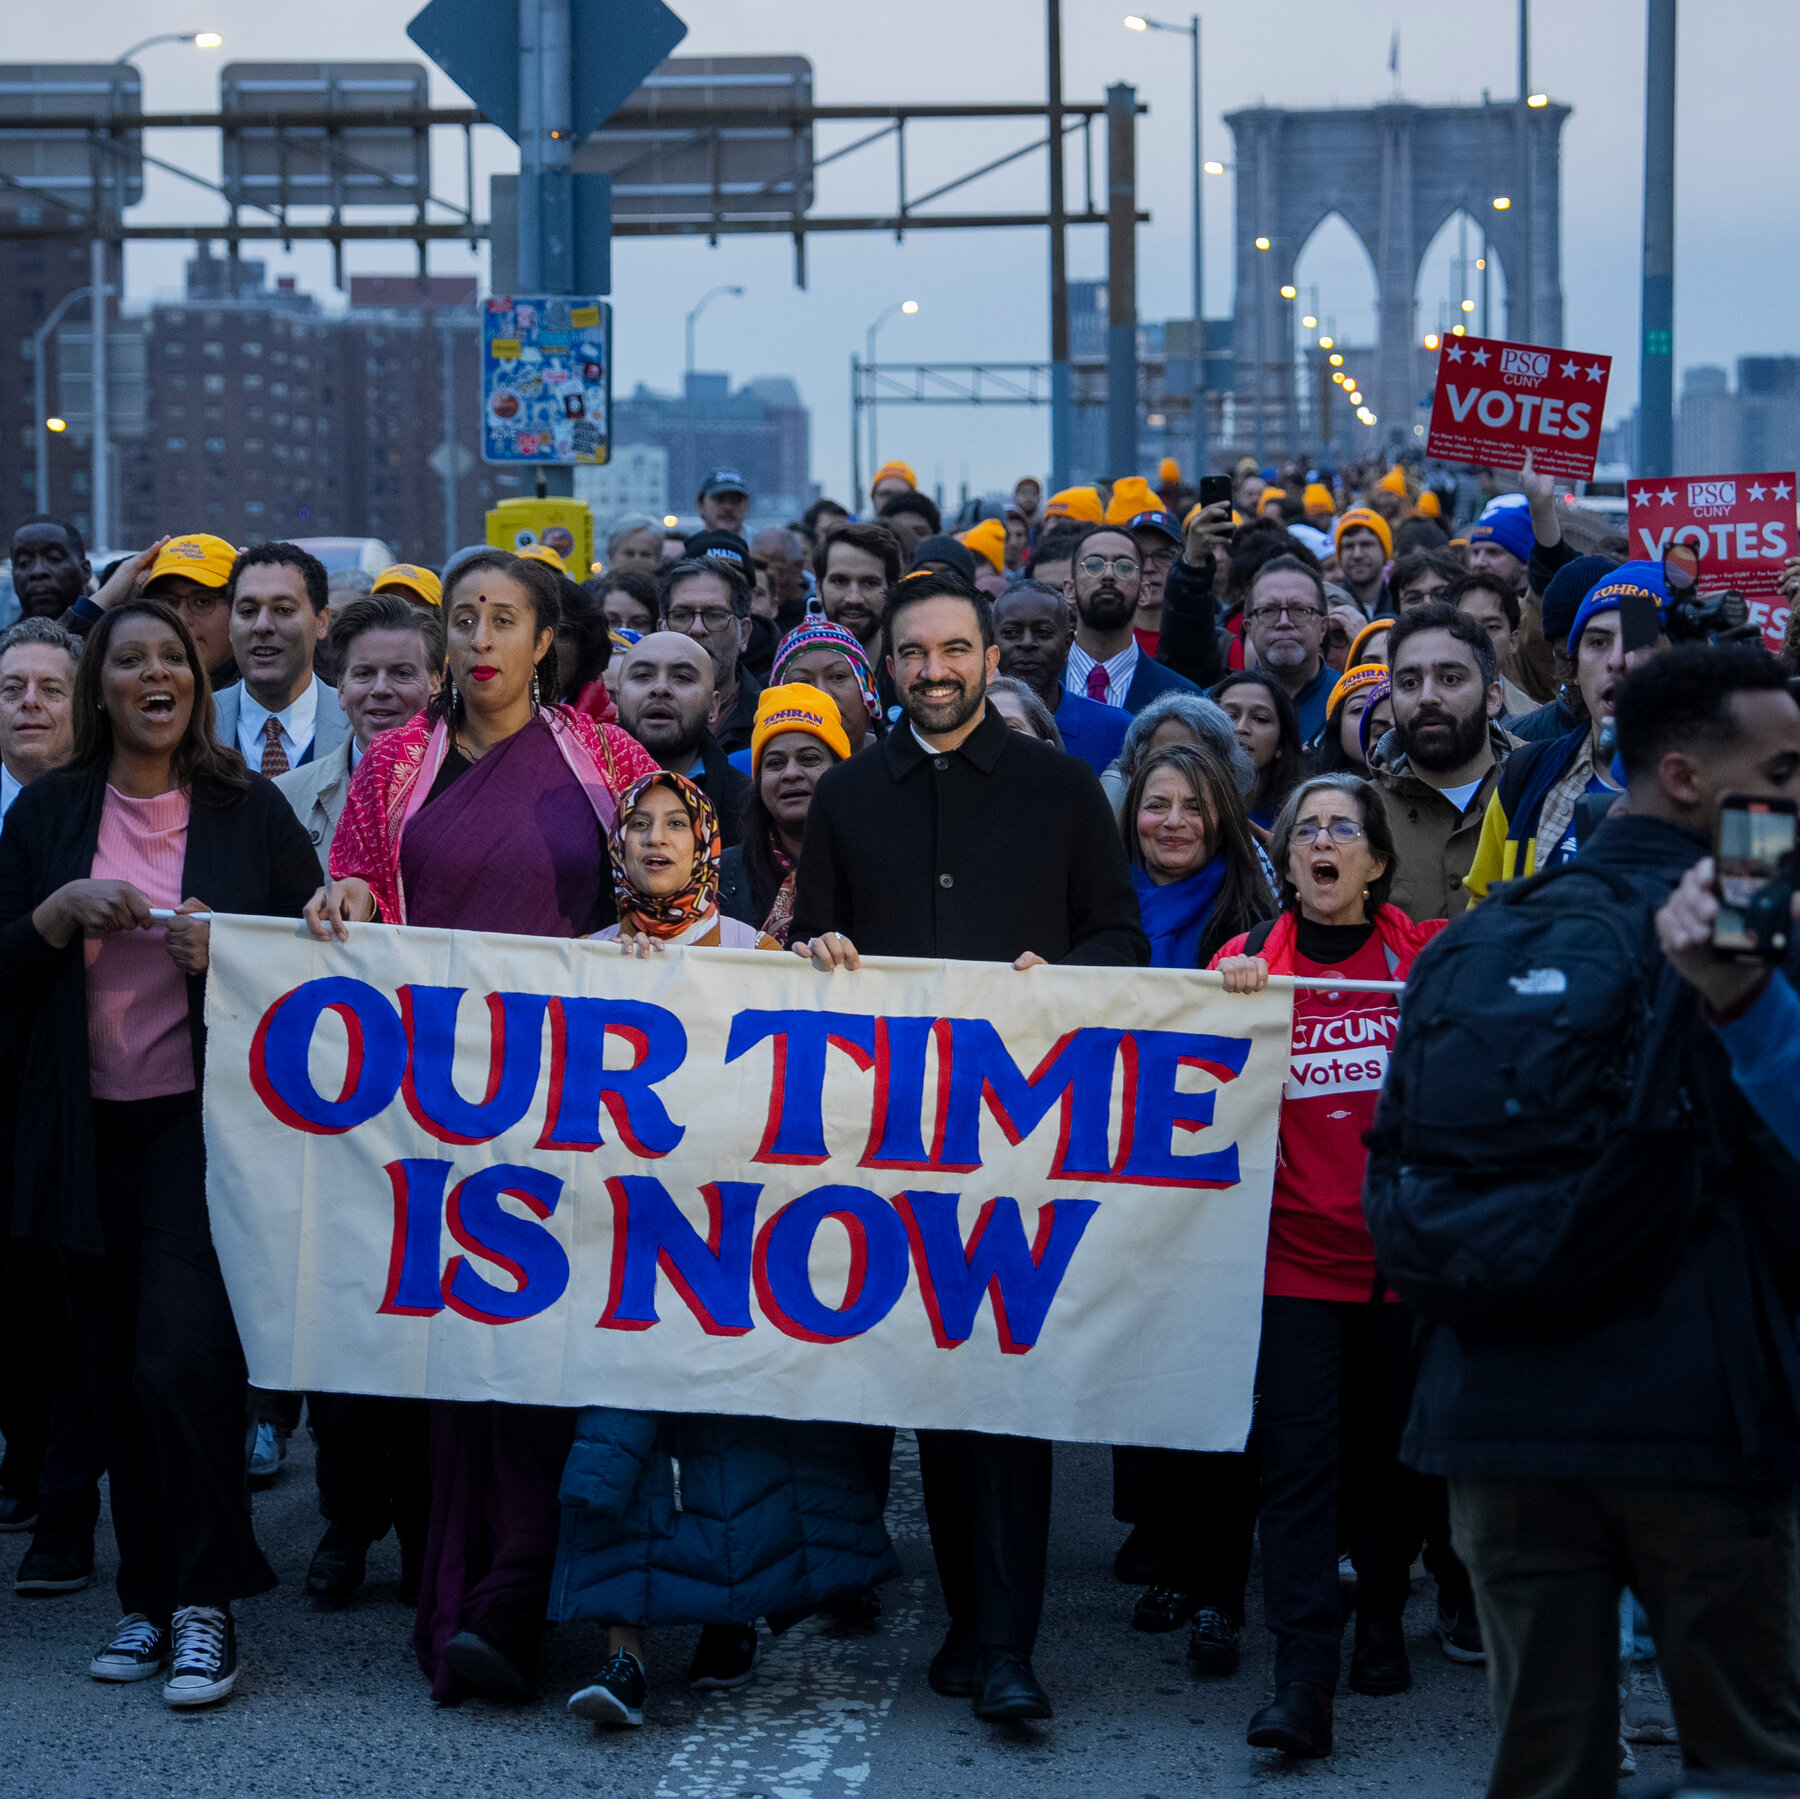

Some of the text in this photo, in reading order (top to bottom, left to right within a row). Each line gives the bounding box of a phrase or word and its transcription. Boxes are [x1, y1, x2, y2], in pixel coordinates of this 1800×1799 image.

[1503, 350, 1548, 376] PSC
[1504, 373, 1542, 388] CUNY
[1445, 384, 1592, 440] VOTES
[1691, 482, 1735, 505] PSC
[1693, 506, 1731, 518] CUNY
[1638, 521, 1788, 562] VOTES
[764, 709, 823, 725] ZOHRAN
[249, 976, 1252, 1190] OUR TIME
[1290, 1058, 1382, 1087] Votes
[378, 1158, 1101, 1355] IS NOW
